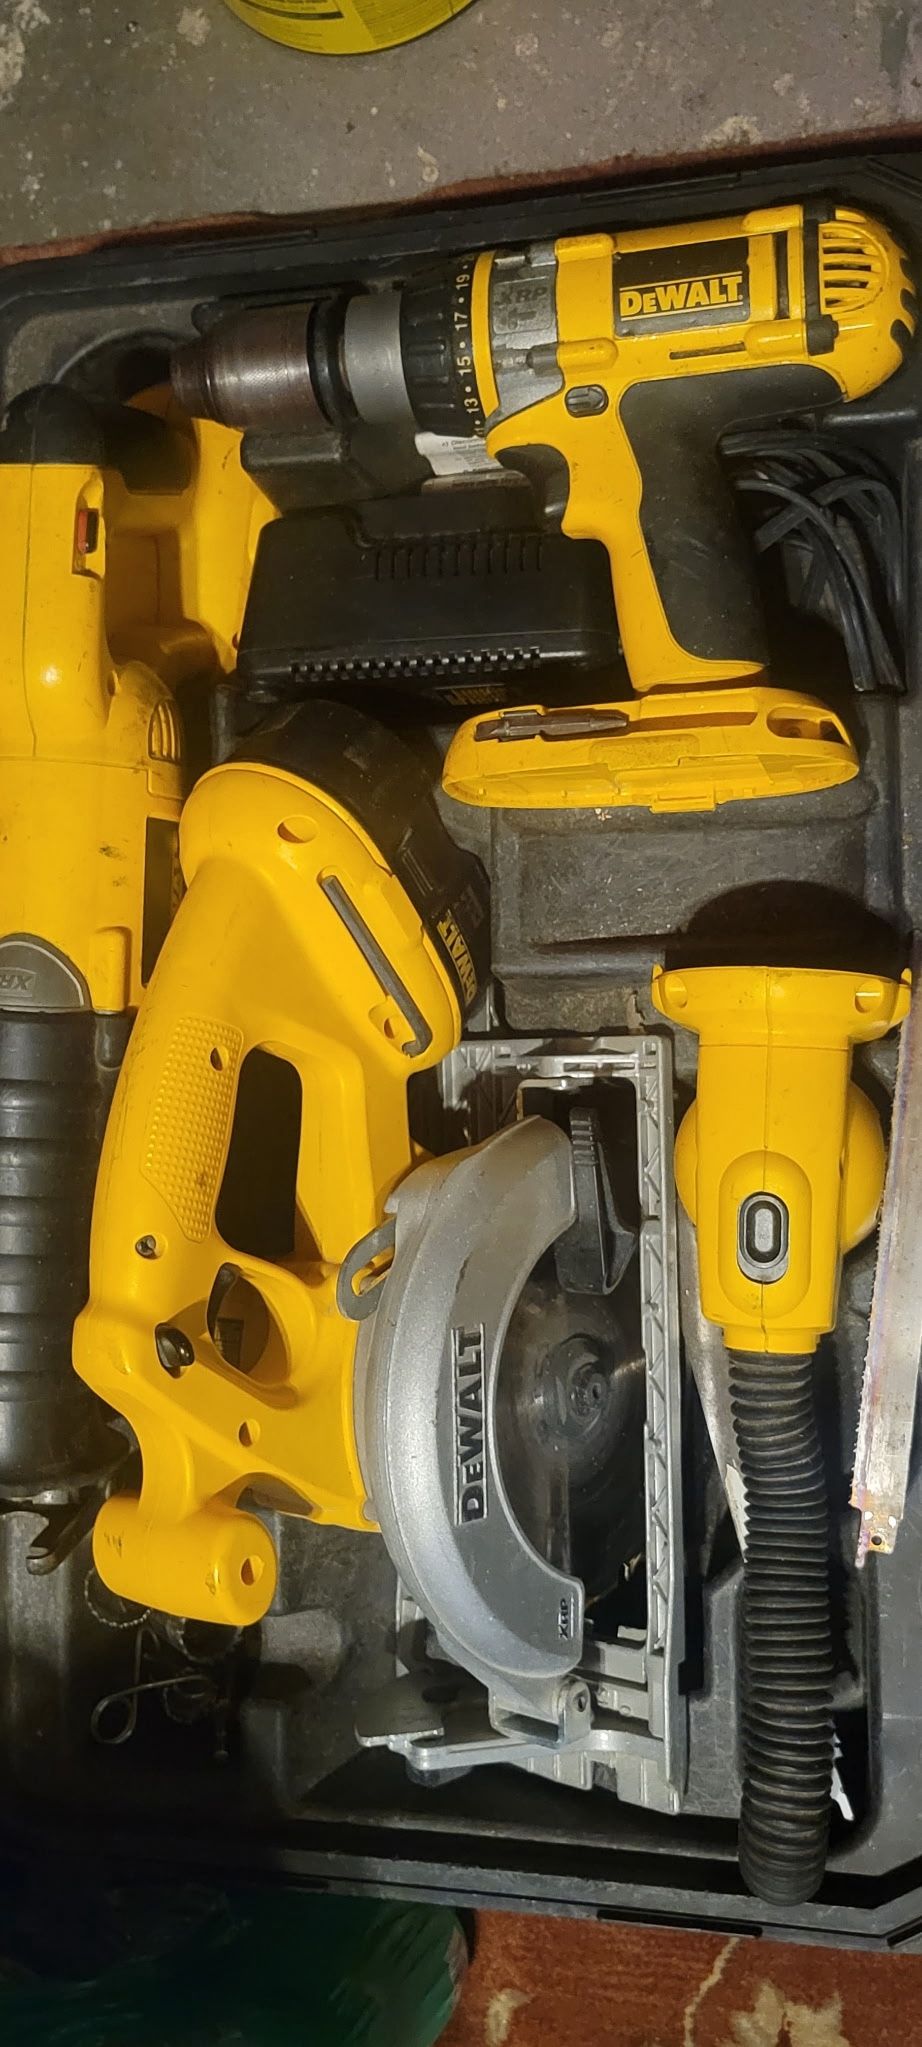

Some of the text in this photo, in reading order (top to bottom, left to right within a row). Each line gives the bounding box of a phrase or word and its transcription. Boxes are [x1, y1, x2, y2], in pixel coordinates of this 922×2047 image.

[455, 273, 470, 290] 19
[454, 311, 468, 331] 17
[457, 355, 472, 376] 15
[463, 397, 481, 414] 13
